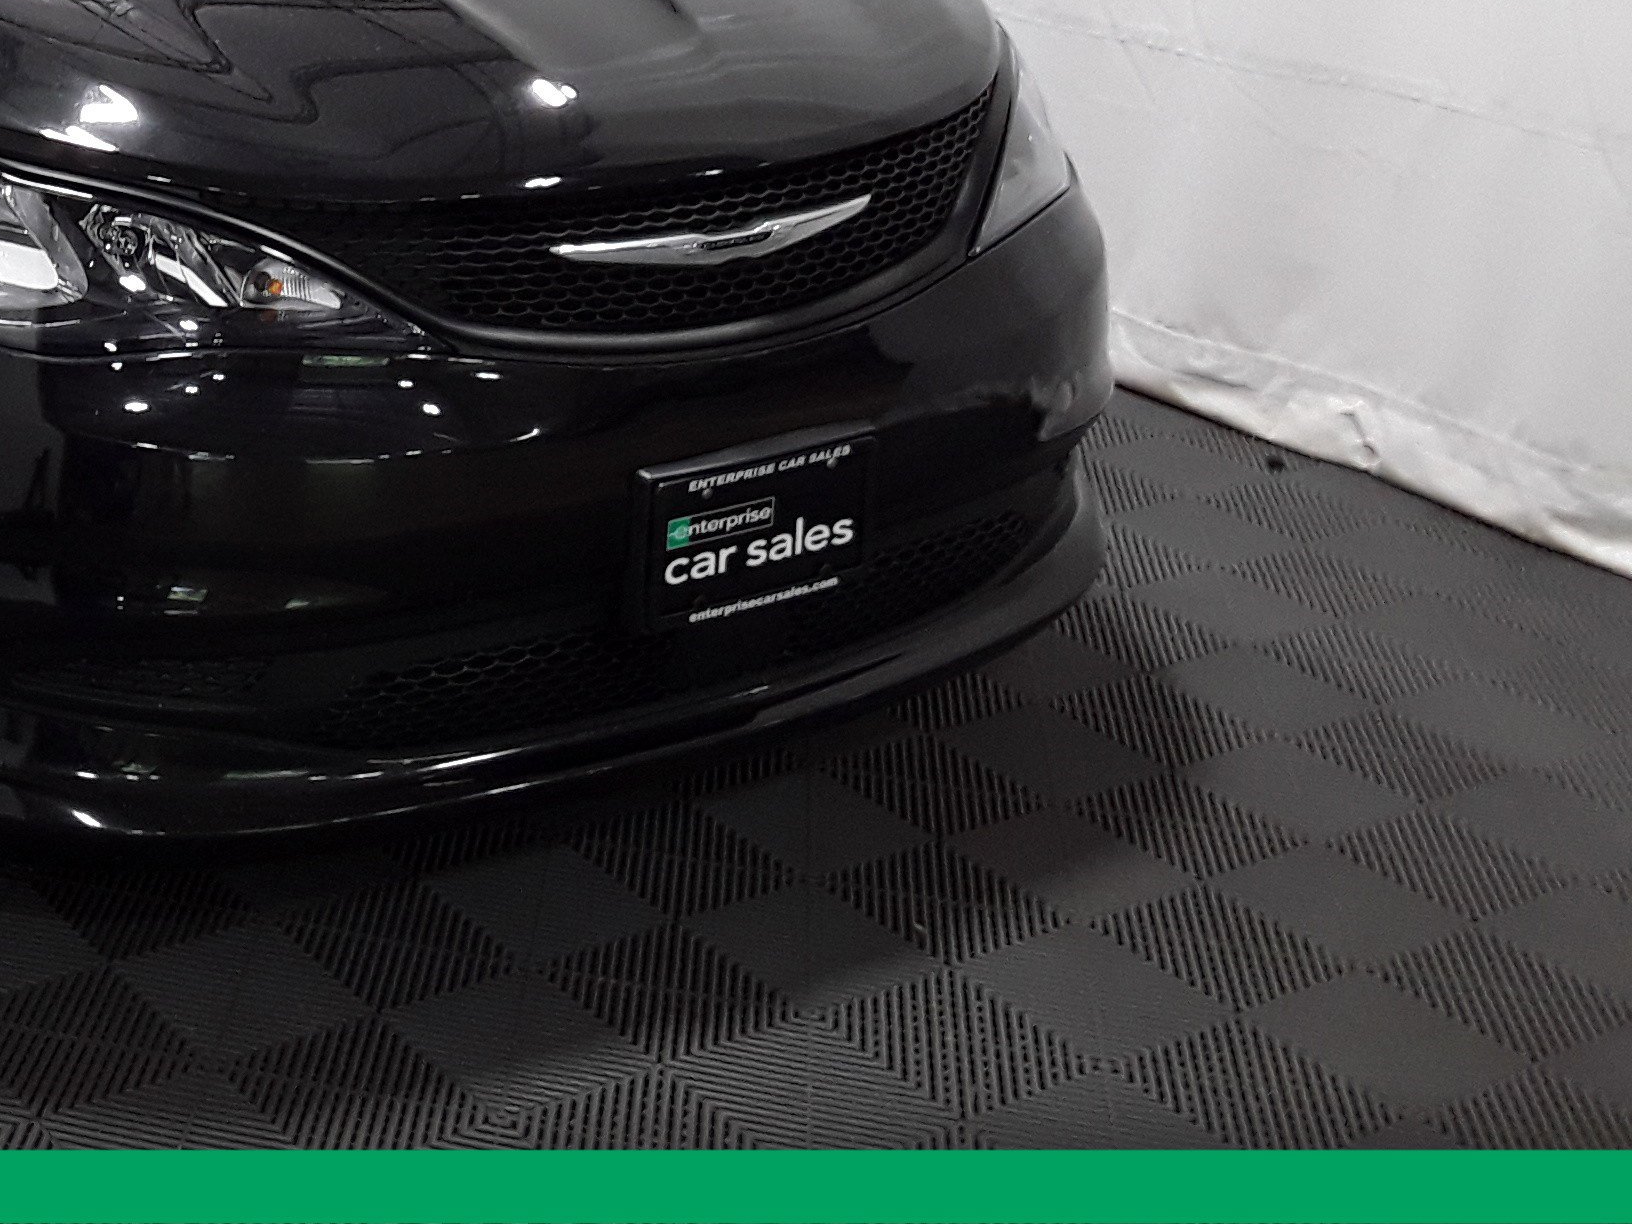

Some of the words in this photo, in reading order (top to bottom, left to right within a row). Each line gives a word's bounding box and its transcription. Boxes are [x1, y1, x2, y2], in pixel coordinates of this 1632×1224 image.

[688, 462, 776, 493] ENTERPRISE
[778, 455, 806, 472] CAR
[808, 444, 851, 464] SALES
[671, 507, 772, 539] enterprise
[664, 545, 738, 585] car
[746, 516, 854, 567] sales
[688, 576, 839, 623] enterprisecarsales.com
